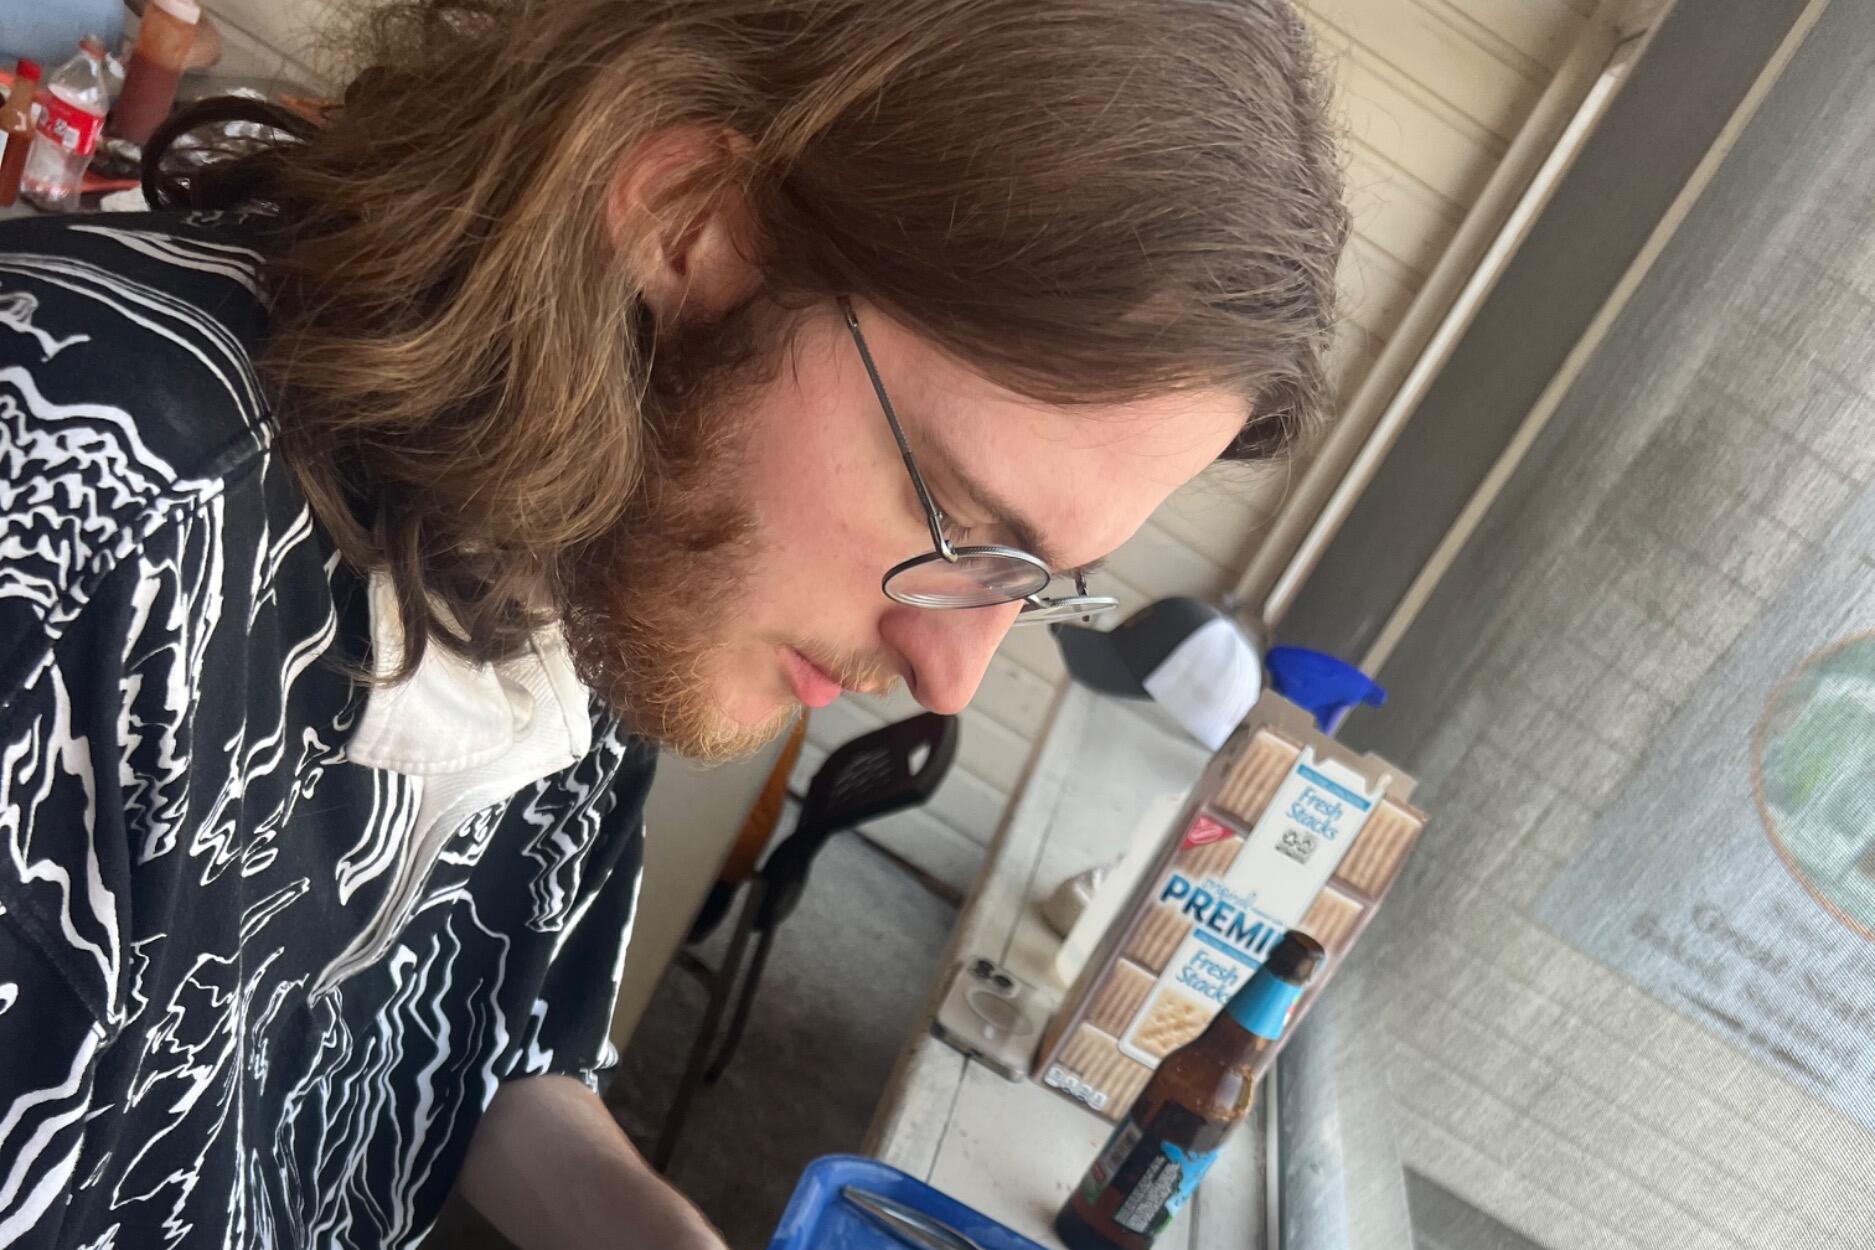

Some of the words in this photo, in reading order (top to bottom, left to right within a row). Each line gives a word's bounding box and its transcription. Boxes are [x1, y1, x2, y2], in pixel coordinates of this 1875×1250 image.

[1285, 801, 1338, 841] Stacks
[1299, 786, 1343, 821] Fresh
[1160, 873, 1285, 954] PREMI
[1189, 949, 1239, 987] Fresh
